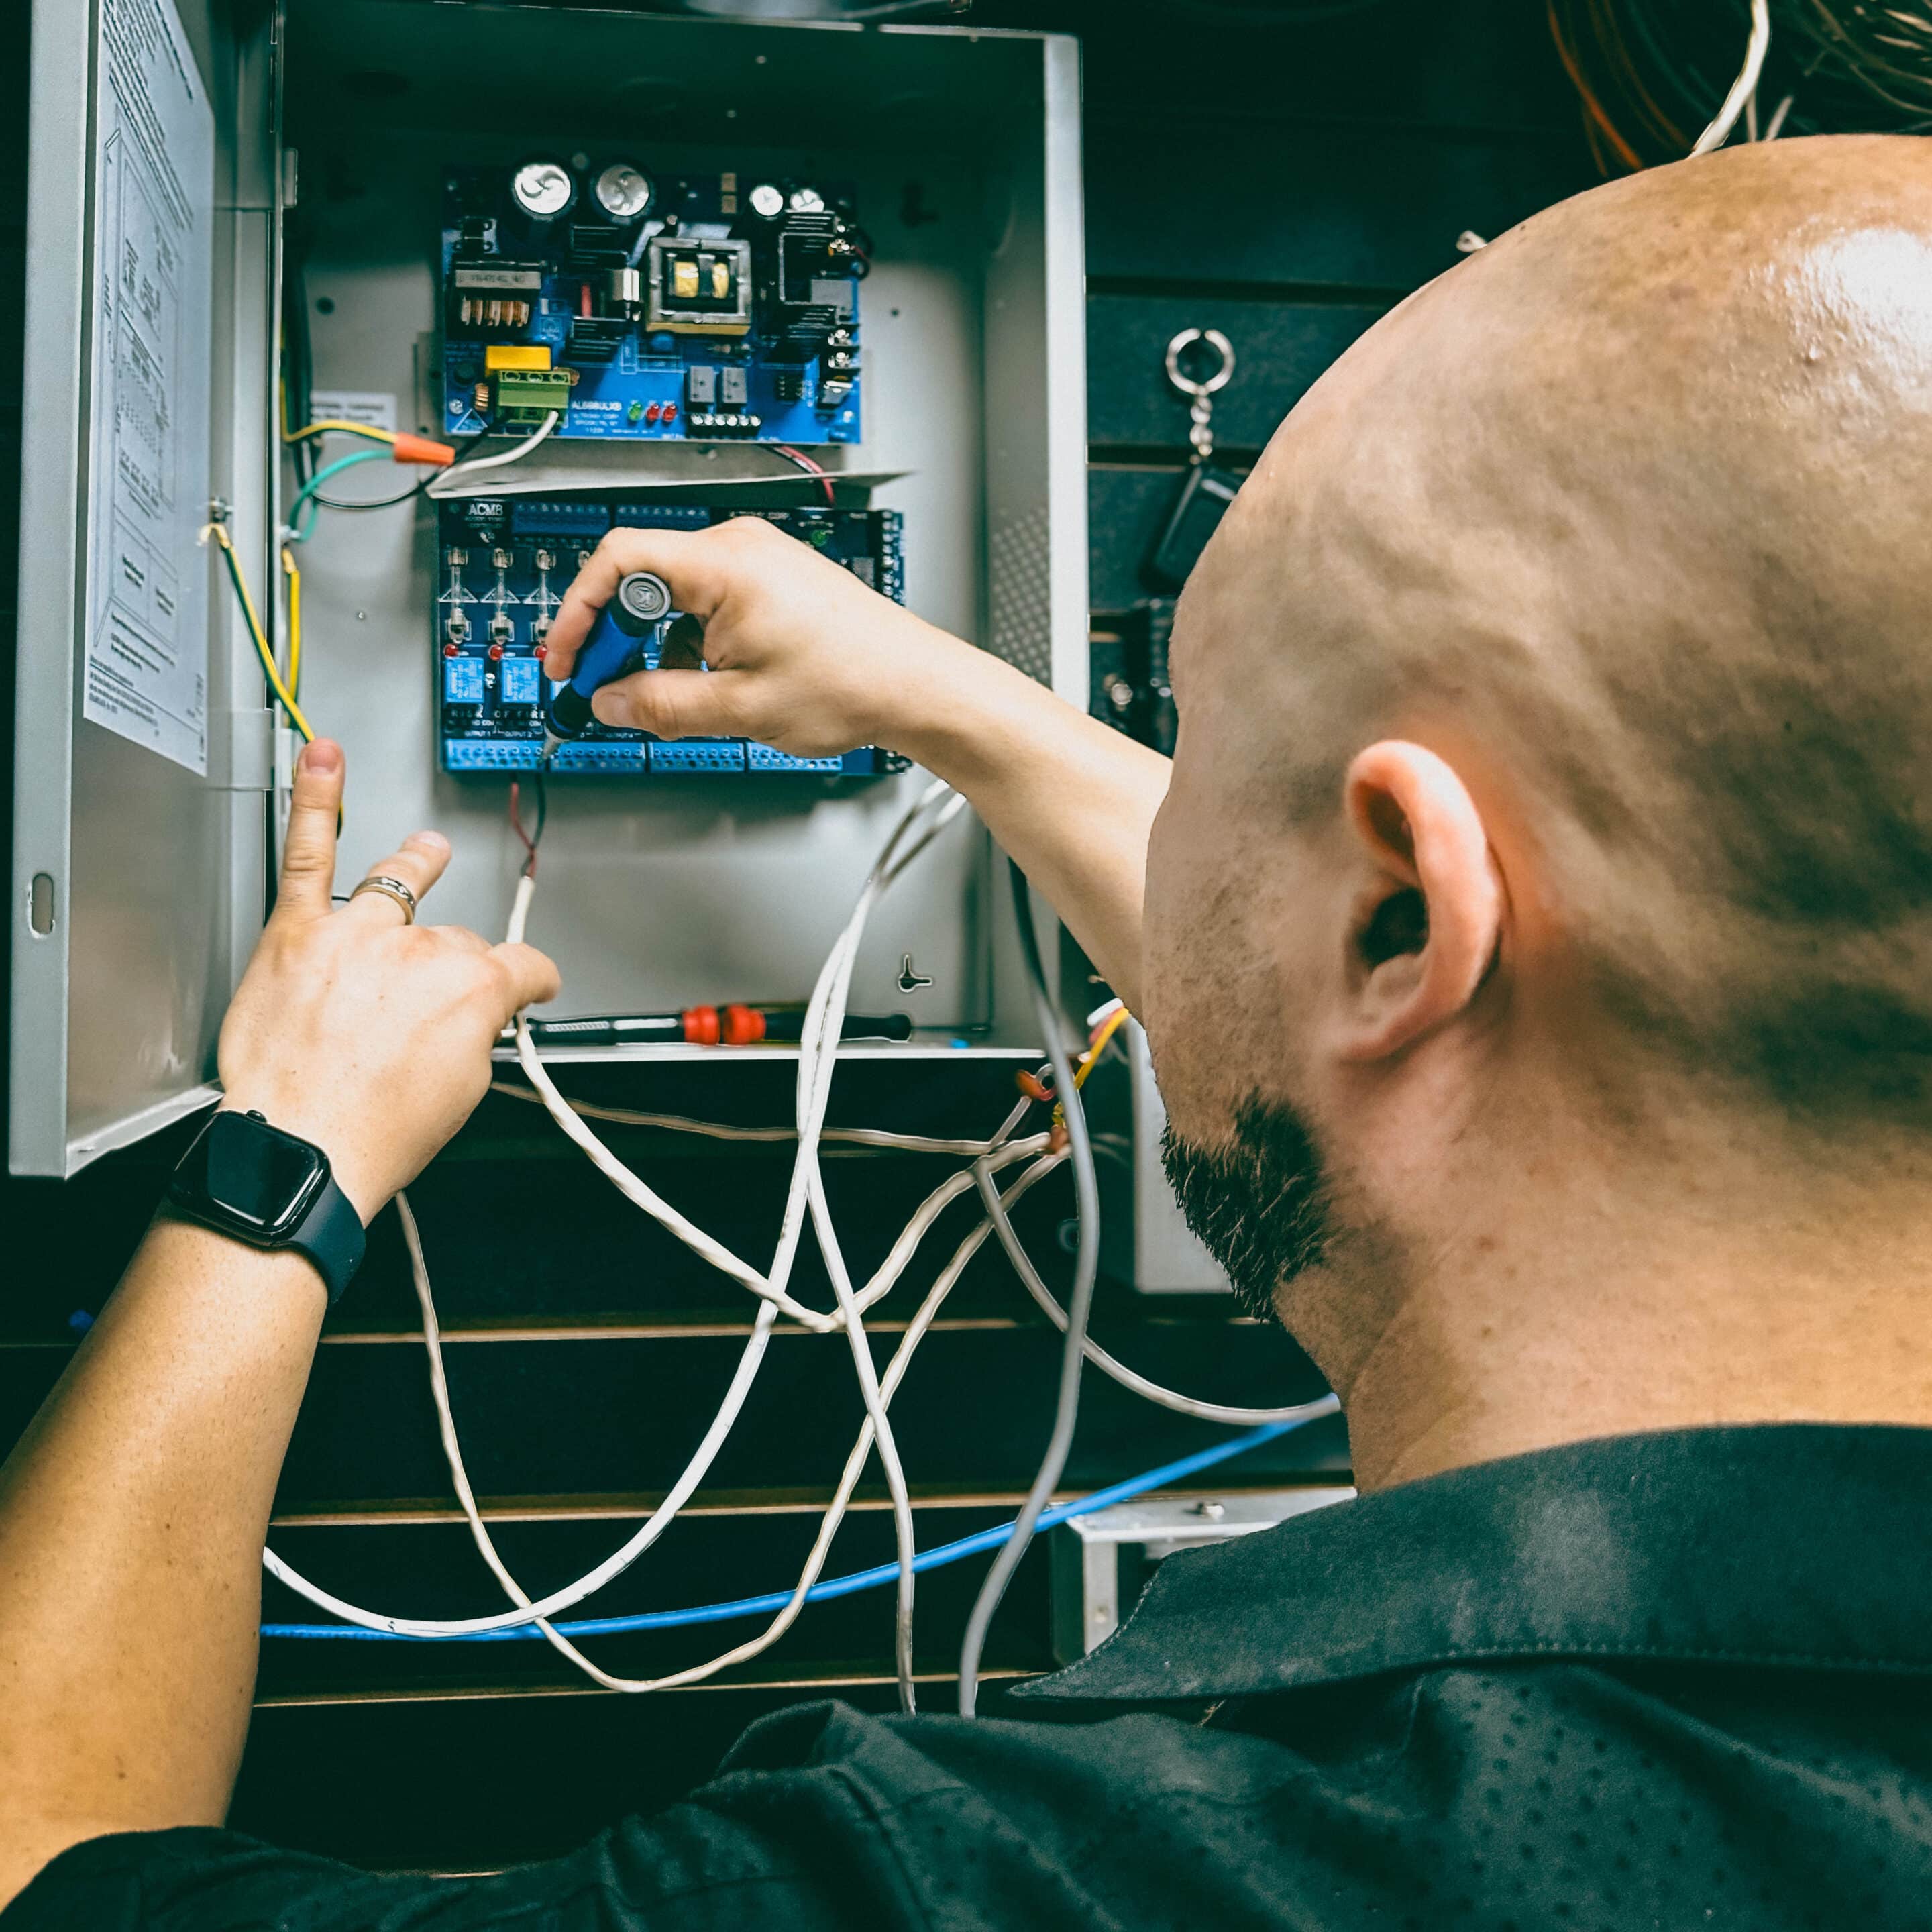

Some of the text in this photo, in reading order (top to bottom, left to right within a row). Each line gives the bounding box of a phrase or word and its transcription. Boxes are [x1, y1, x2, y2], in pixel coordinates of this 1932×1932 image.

[451, 710, 546, 719] RISK OF FIRE
